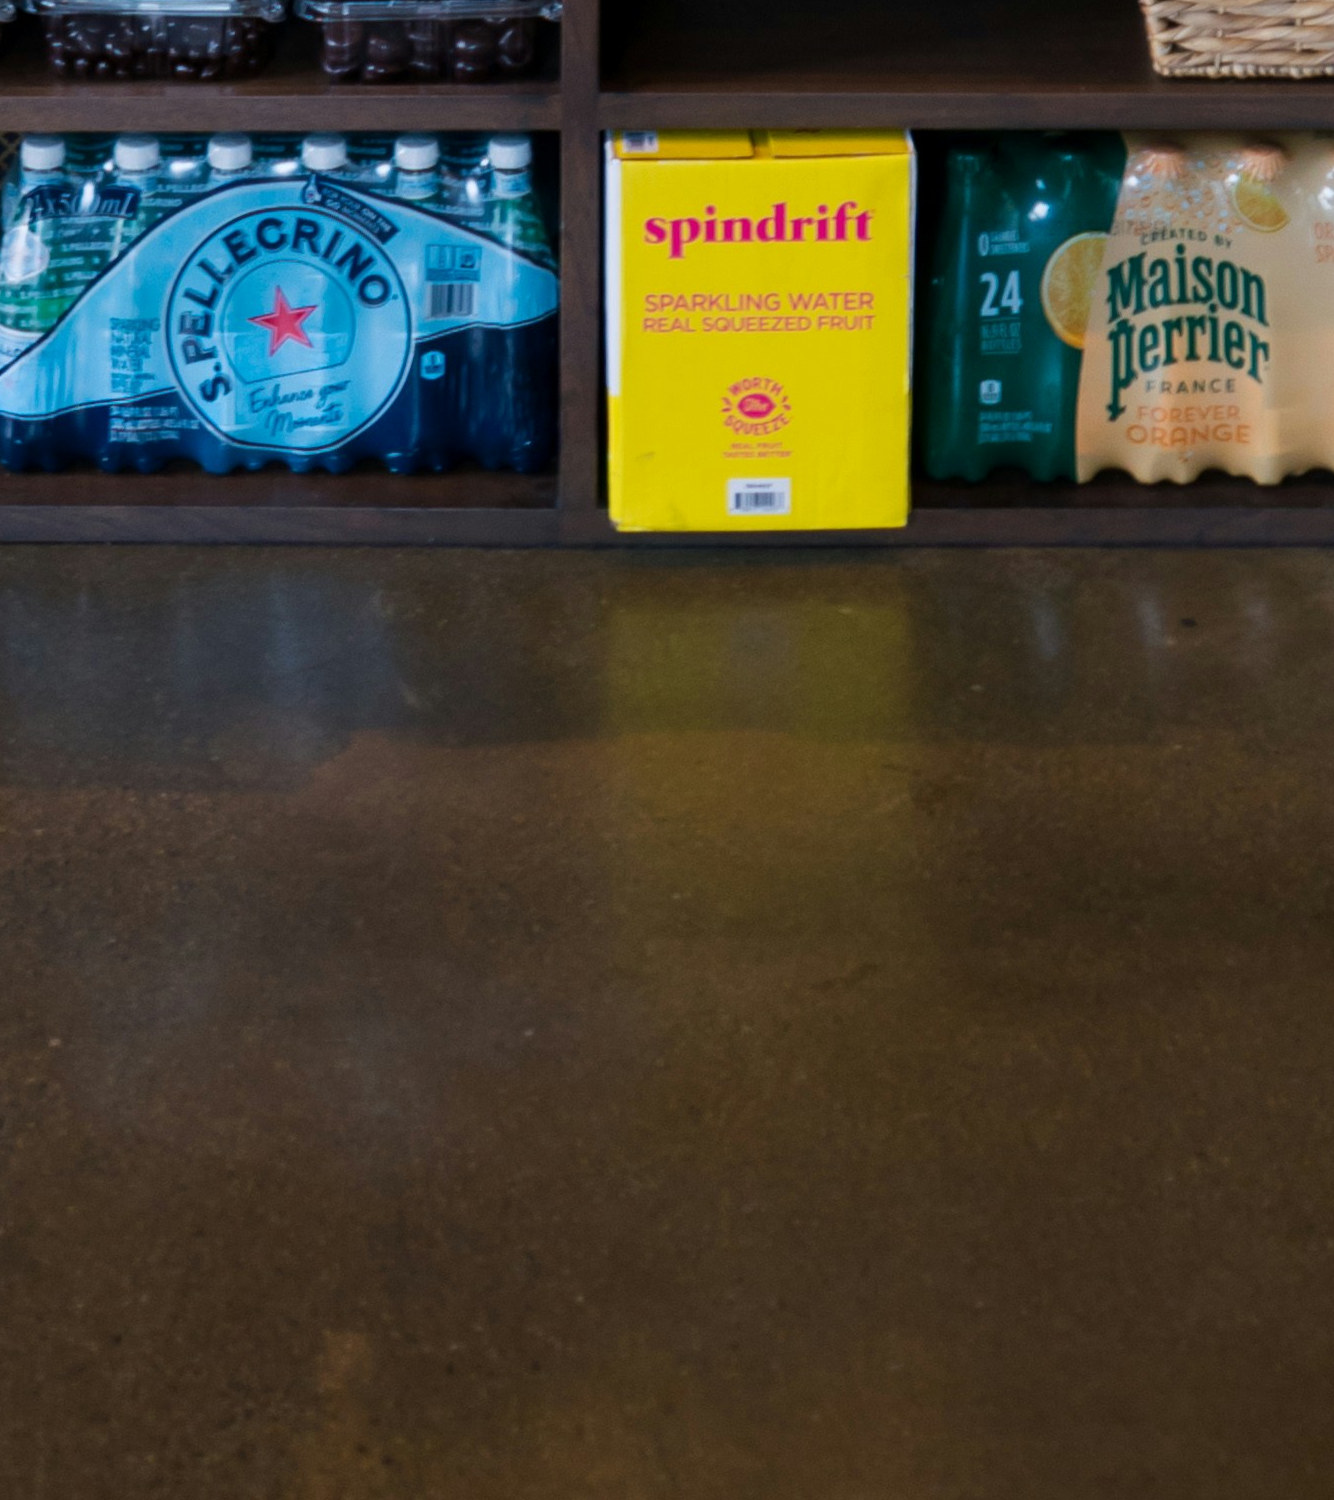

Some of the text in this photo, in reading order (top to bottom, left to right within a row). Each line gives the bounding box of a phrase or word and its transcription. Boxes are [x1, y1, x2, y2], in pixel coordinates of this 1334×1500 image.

[643, 202, 873, 259] spindrift
[1141, 230, 1232, 249] CREATED BY
[979, 270, 1023, 318] 24
[1106, 244, 1269, 326] Maison
[179, 216, 391, 403] S.PELLEGRINO
[644, 292, 874, 313] SPARKLING WATER
[643, 315, 875, 333] REAL SQUEEZED FRUIT
[248, 380, 352, 414] Enhance your
[728, 377, 783, 396] WORTH
[1146, 377, 1236, 395] FRANCE
[266, 402, 344, 436] Moments
[723, 413, 790, 436] SQUEEZE
[1137, 405, 1241, 425] FOREVER
[1126, 424, 1252, 448] ORANGE
